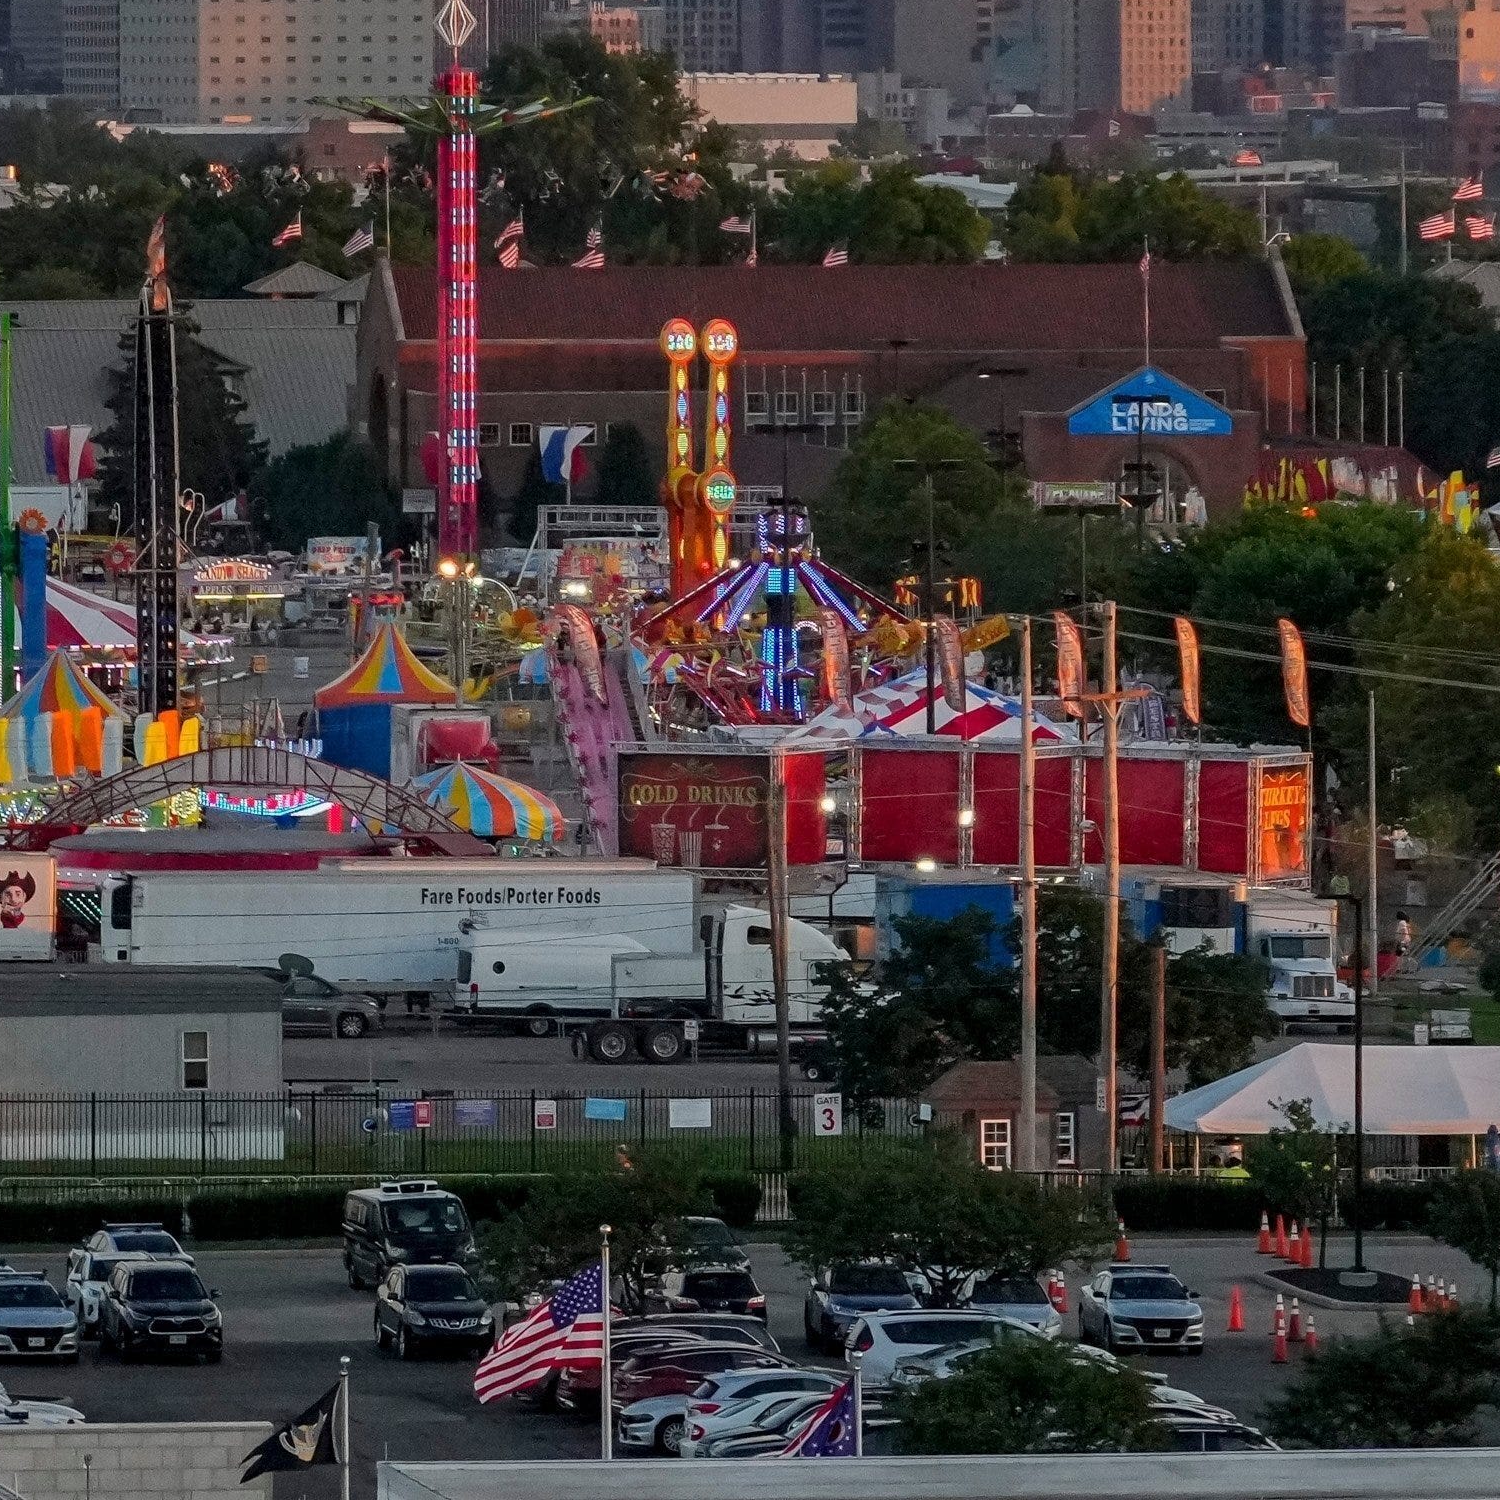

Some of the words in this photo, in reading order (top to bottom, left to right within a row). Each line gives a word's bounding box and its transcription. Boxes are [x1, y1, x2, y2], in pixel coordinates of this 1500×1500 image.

[629, 784, 679, 805] COLD
[688, 785, 758, 807] DRINKS
[421, 888, 453, 904] Fare
[458, 887, 553, 904] Foods/Porter
[557, 887, 601, 904] Foods
[816, 1096, 840, 1105] GATE
[822, 1108, 835, 1131] 3
